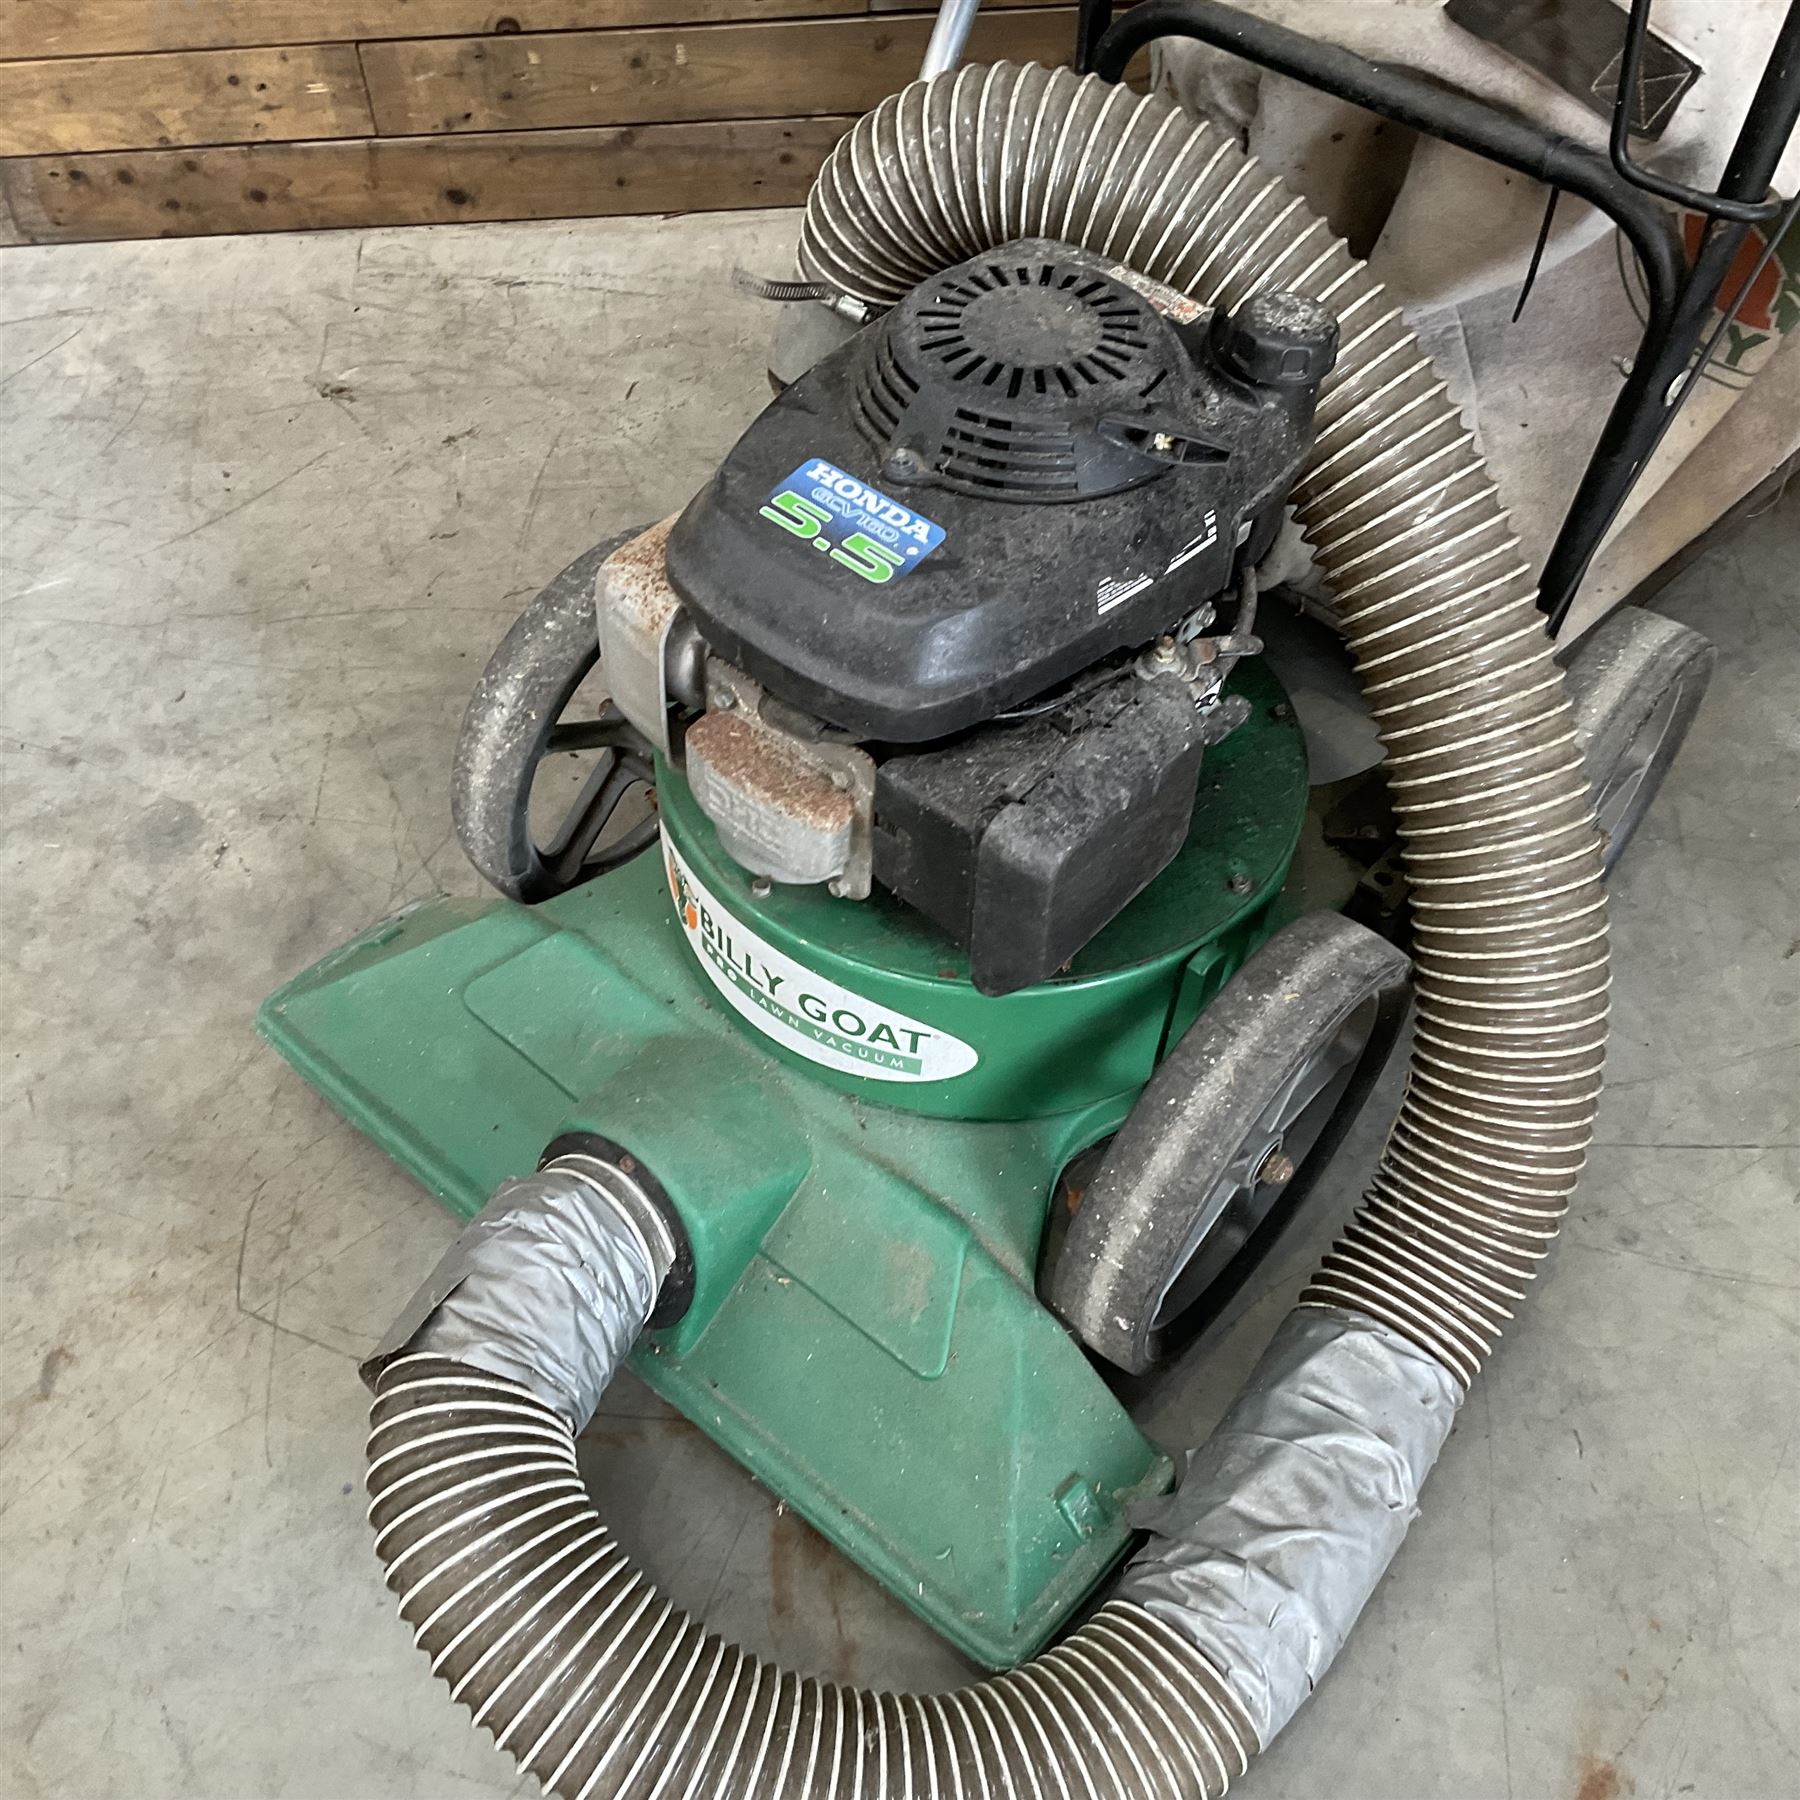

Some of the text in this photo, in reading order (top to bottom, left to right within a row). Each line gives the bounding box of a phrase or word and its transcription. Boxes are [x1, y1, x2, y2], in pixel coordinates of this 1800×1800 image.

[759, 490, 906, 583] 5.5
[806, 463, 931, 544] HONDA
[700, 904, 931, 1054] BILLY GOAT
[706, 945, 904, 1069] PRO LAWN VACUUM
